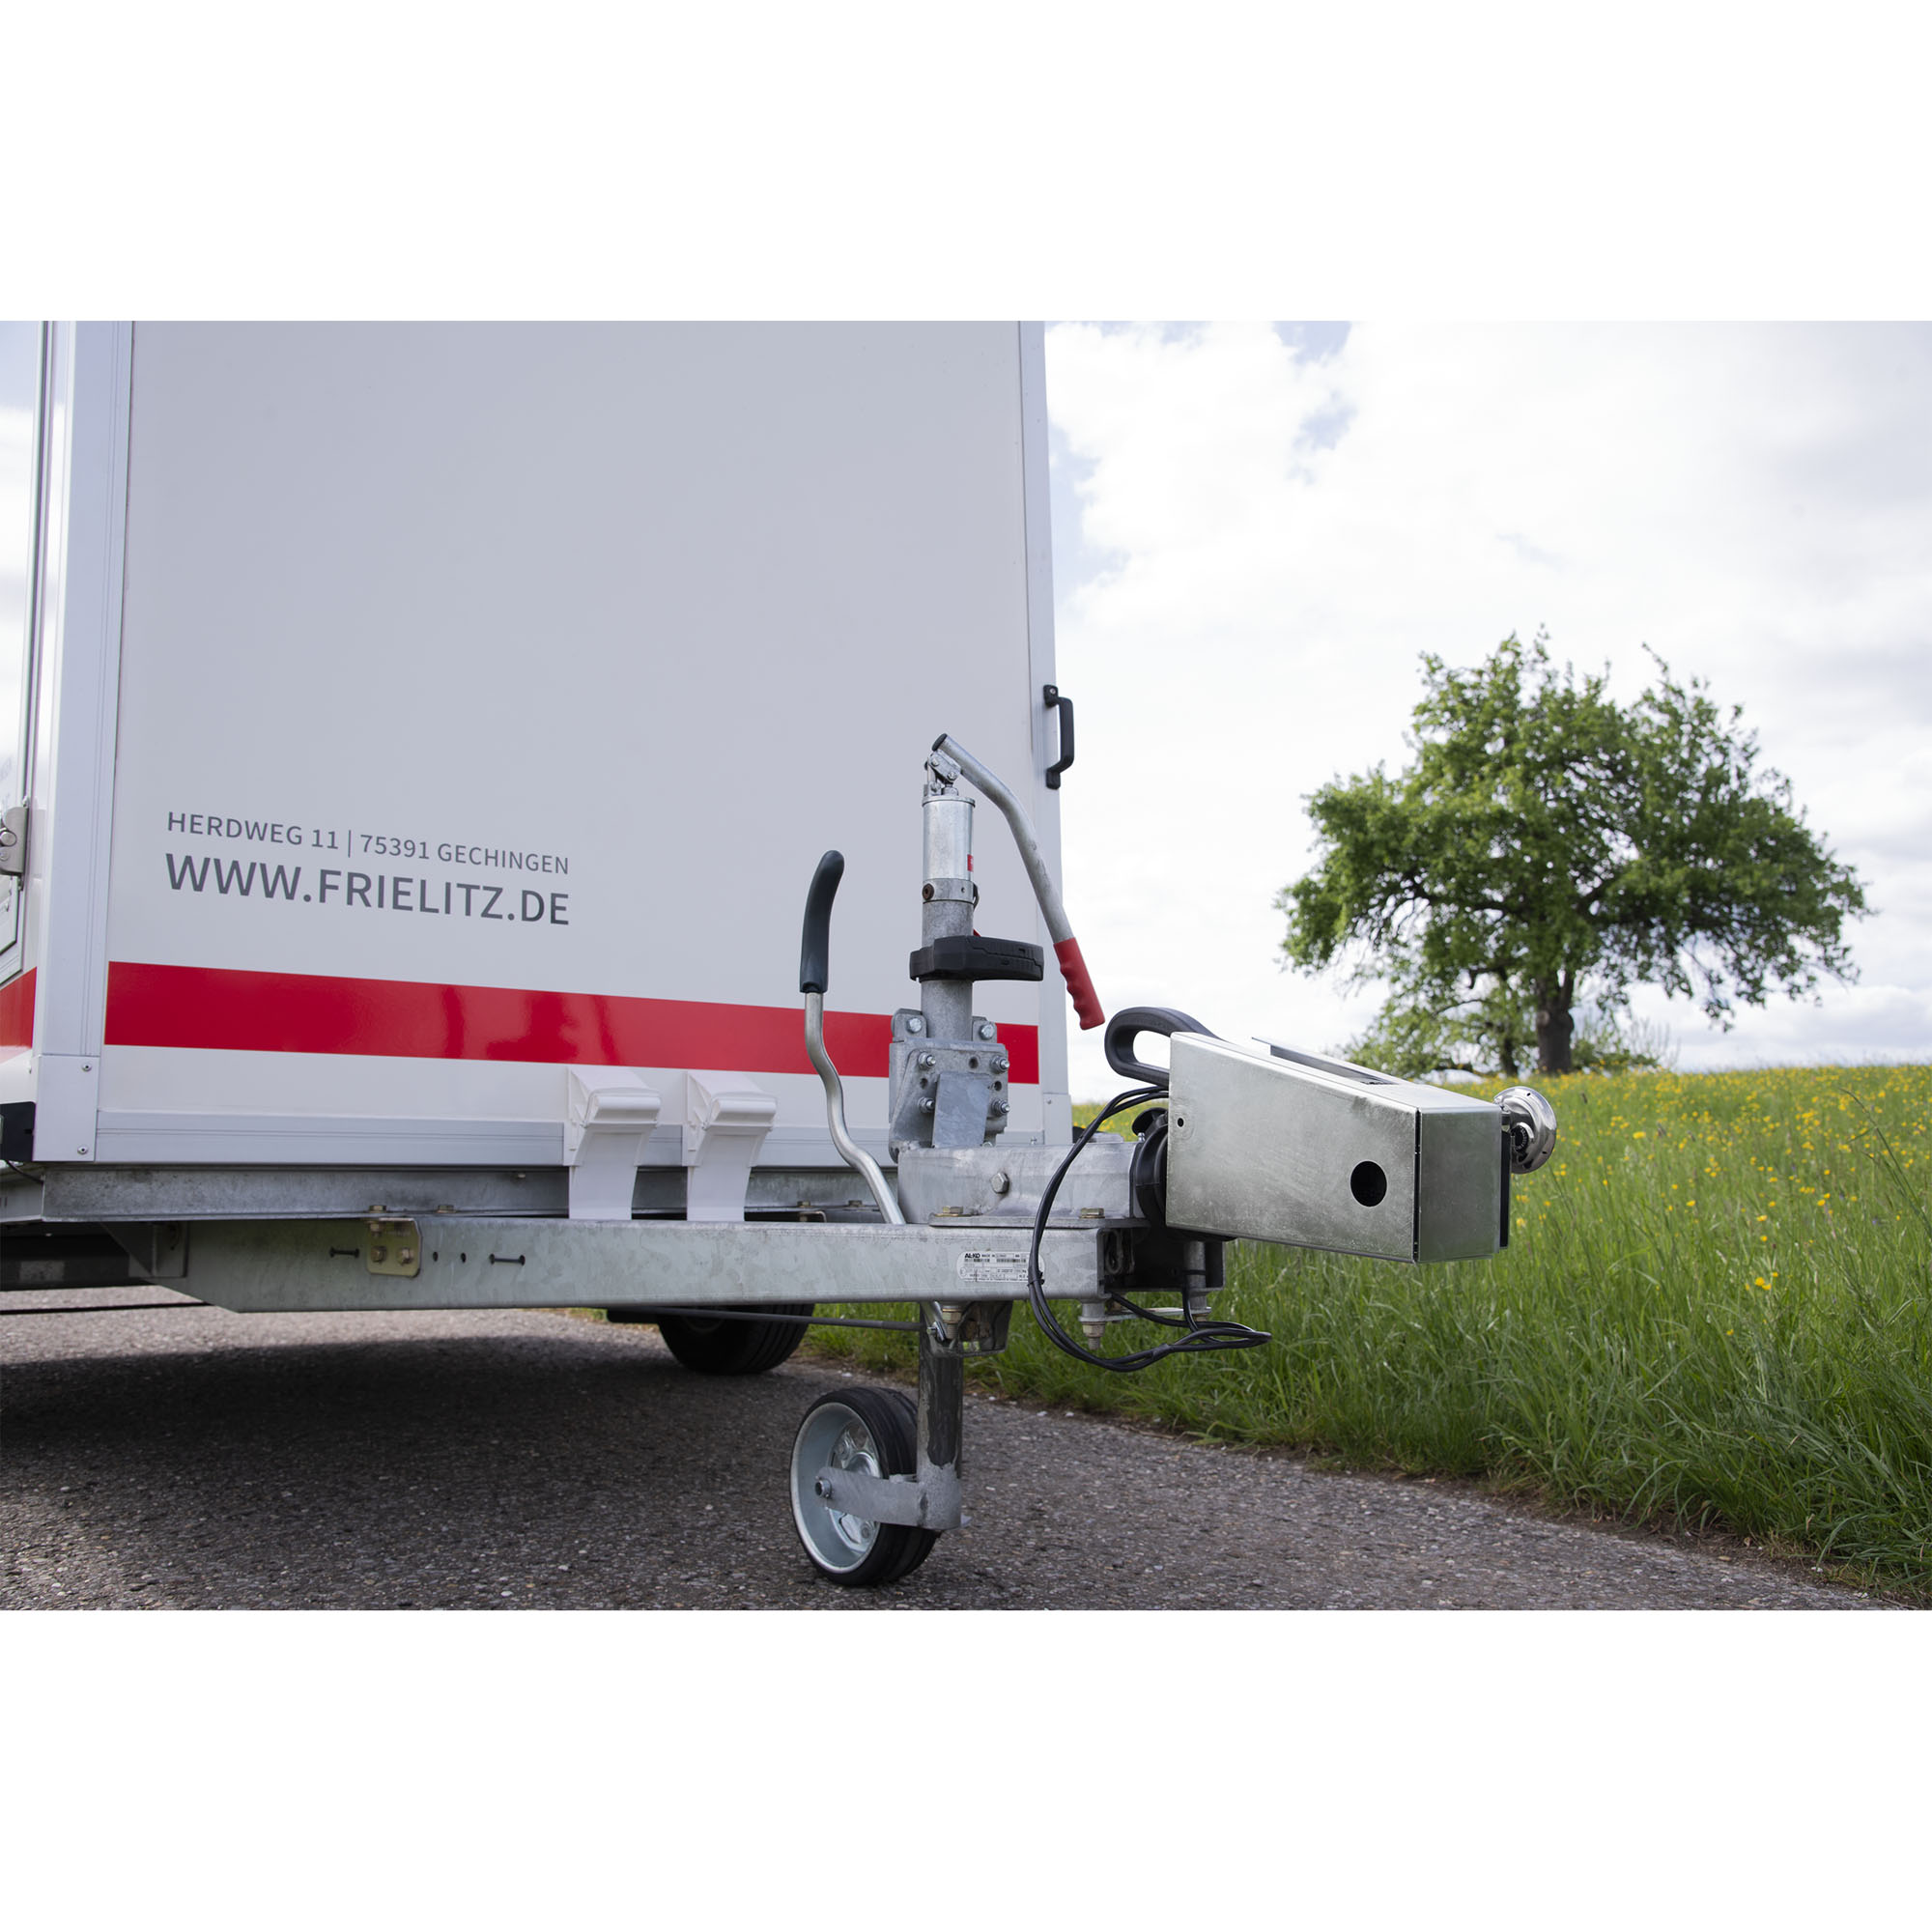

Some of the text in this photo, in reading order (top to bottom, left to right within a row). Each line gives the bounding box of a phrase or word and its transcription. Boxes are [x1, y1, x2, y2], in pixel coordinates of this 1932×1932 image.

[167, 811, 302, 846] HERDWEG
[311, 829, 339, 850] 11
[360, 834, 430, 860] 75391
[437, 842, 569, 875] GECHINGEN
[165, 852, 570, 925] WWW.FRIELITZ.DE
